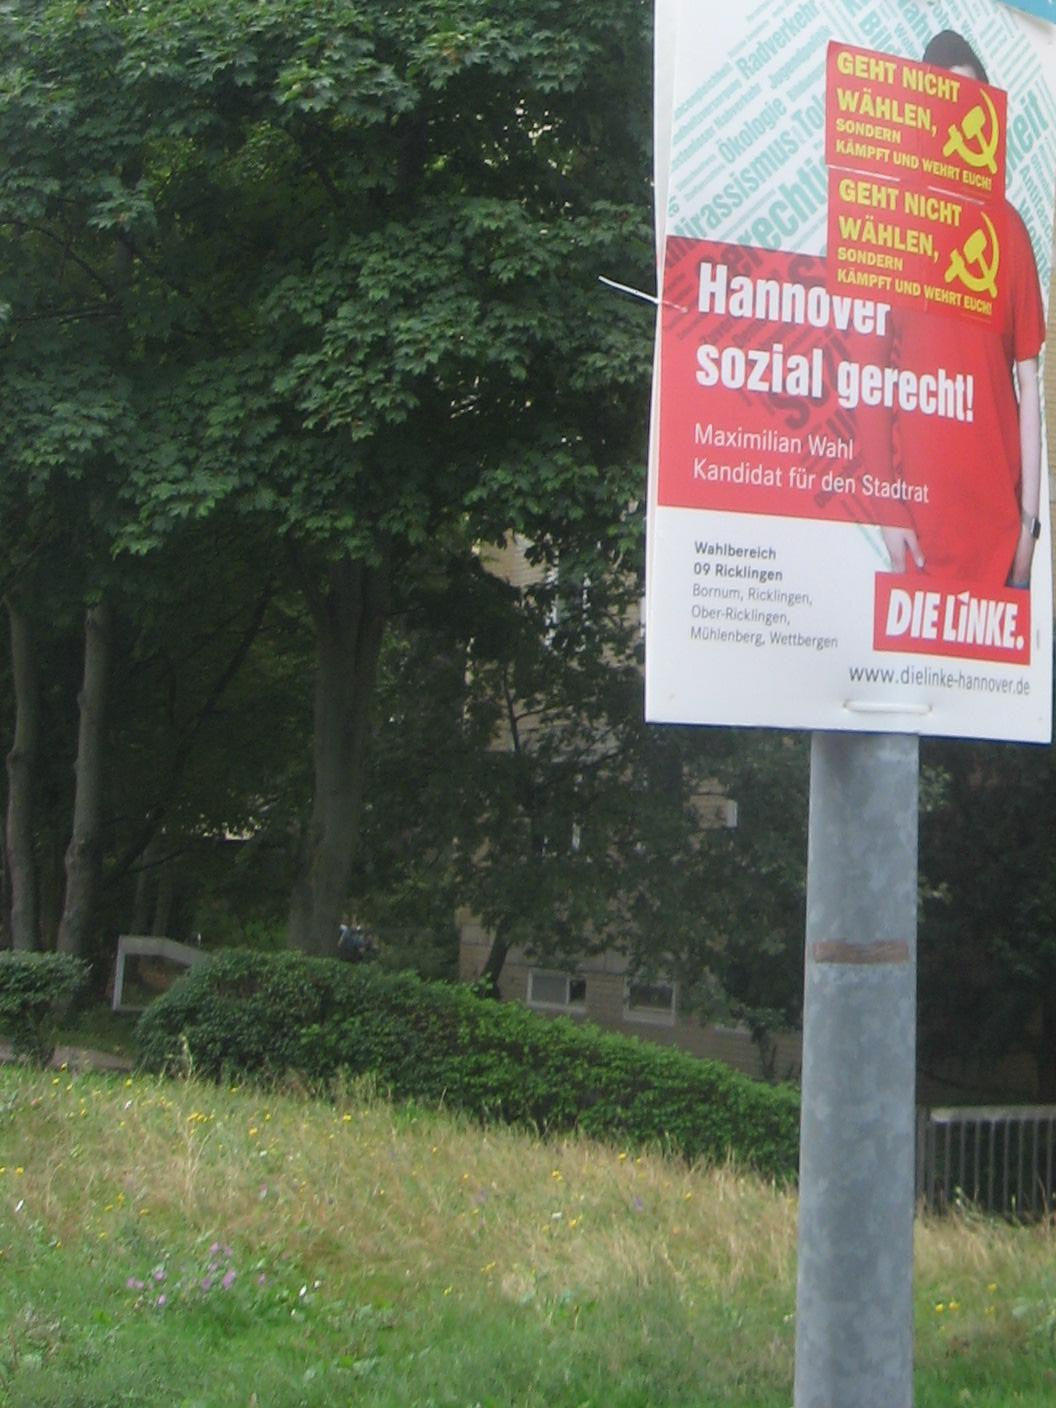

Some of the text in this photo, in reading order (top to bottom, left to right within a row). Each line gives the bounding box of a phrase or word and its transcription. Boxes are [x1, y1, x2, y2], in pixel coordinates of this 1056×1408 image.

[836, 50, 898, 86] GEHT
[902, 66, 961, 104] NICHT
[717, 93, 789, 165] Ökologie
[835, 86, 939, 138] WÄHLEN,
[835, 118, 902, 144] SONDERN
[835, 138, 993, 192] KÄMPFT UND WEHRT EUCH!
[838, 177, 963, 227] GEHT NICHT
[837, 246, 903, 272] SONDERN
[838, 213, 940, 264] WÄHLEN,
[698, 261, 891, 337] Hannover
[837, 267, 993, 316] KÄMPFT UND WEHRT EUCH!
[696, 343, 823, 398] sozial
[837, 360, 974, 423] gerecht!
[694, 423, 854, 461] Maximilian Wahl
[693, 457, 929, 504] Kandidat für den Stadtrat
[693, 562, 783, 583] 09 Ricklingen
[694, 541, 777, 560] Wahlbereich
[691, 604, 791, 626] Ober-Ricklingen,
[692, 583, 813, 607] Bornum, Ricklingen,
[690, 626, 838, 650] Mühlenberg, Wettbergen
[885, 588, 1025, 651] DIE LINKE.
[848, 664, 1030, 697] www.dielinke-hannover.de
